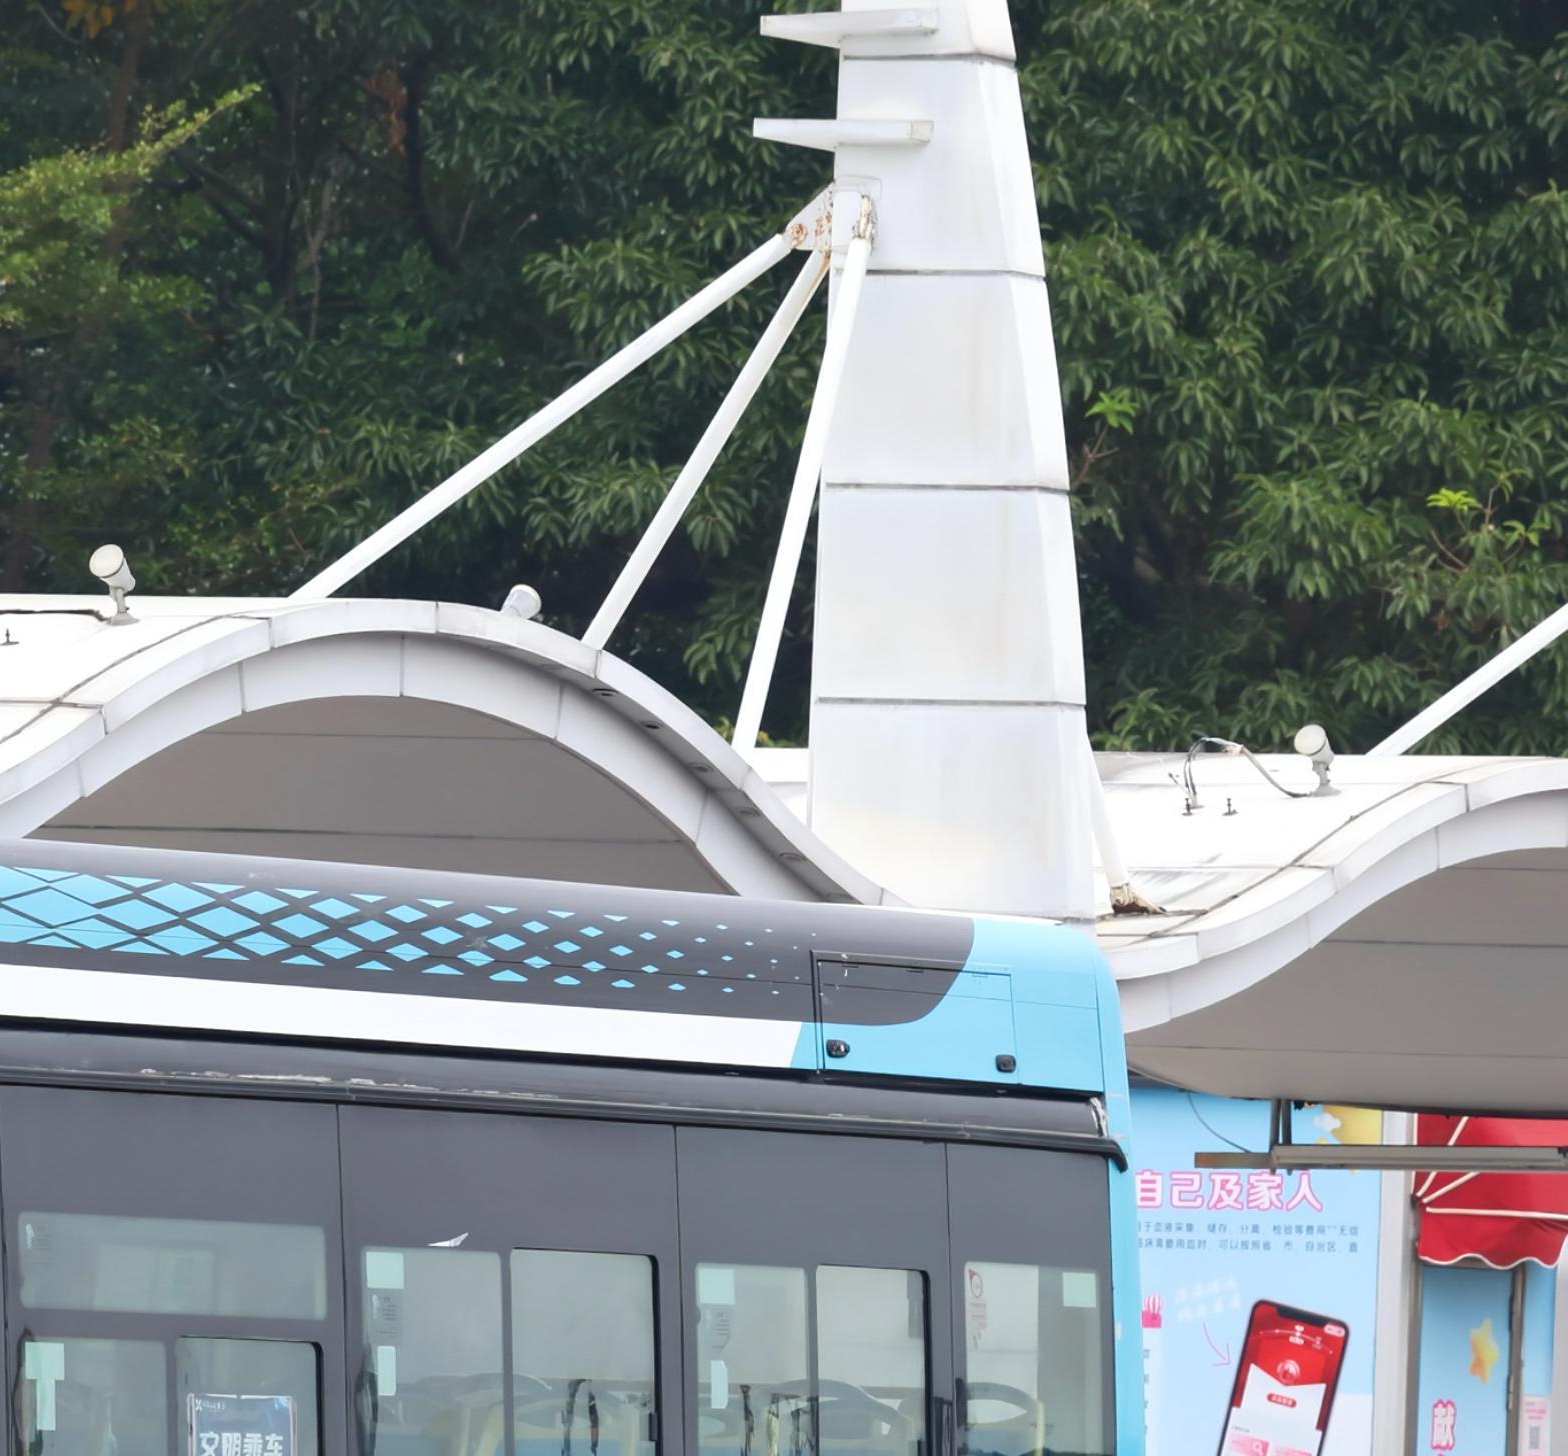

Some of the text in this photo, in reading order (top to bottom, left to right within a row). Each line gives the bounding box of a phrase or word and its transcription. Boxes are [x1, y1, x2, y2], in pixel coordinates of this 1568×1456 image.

[1135, 1168, 1323, 1211] 自己及家人
